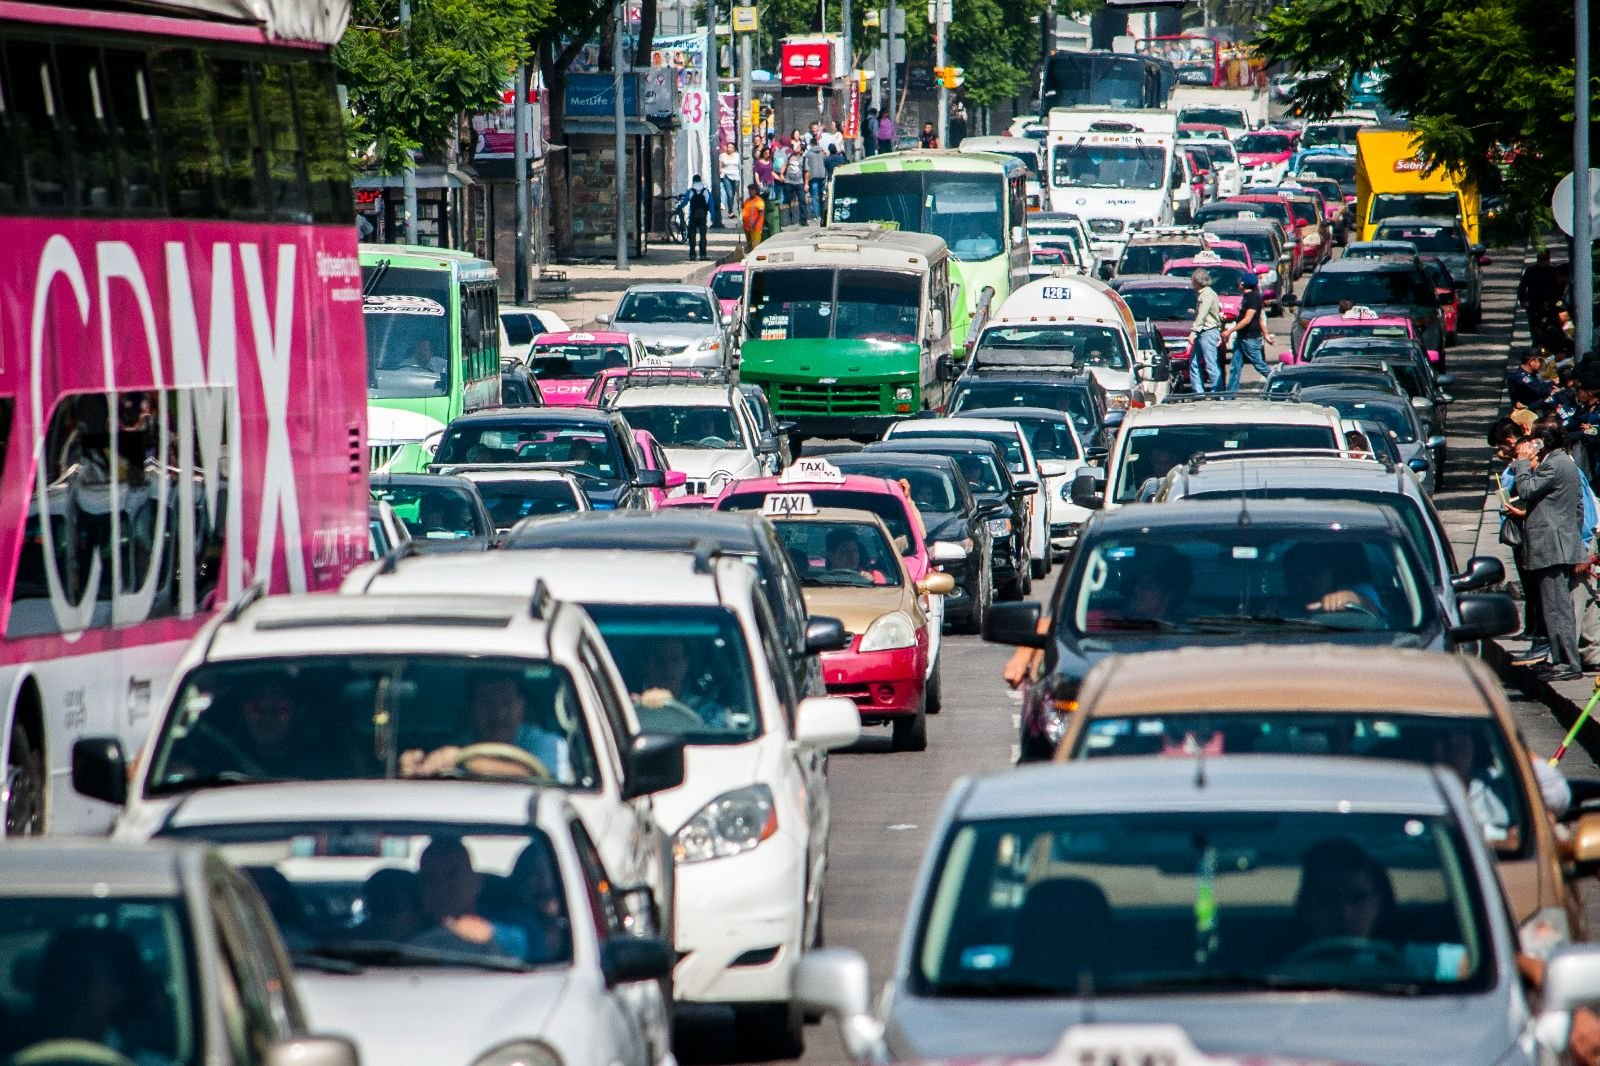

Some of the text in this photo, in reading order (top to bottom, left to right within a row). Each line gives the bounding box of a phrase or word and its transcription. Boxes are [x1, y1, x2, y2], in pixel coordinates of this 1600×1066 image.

[570, 96, 608, 106] MetLife
[681, 92, 703, 123] 43
[1396, 159, 1427, 170] Sabri
[1044, 287, 1071, 299] 428-1
[646, 358, 662, 366] TAXI
[543, 385, 587, 394] CDM
[31, 234, 307, 643] CDMX
[799, 462, 825, 472] TAXI
[770, 497, 805, 512] TAXI
